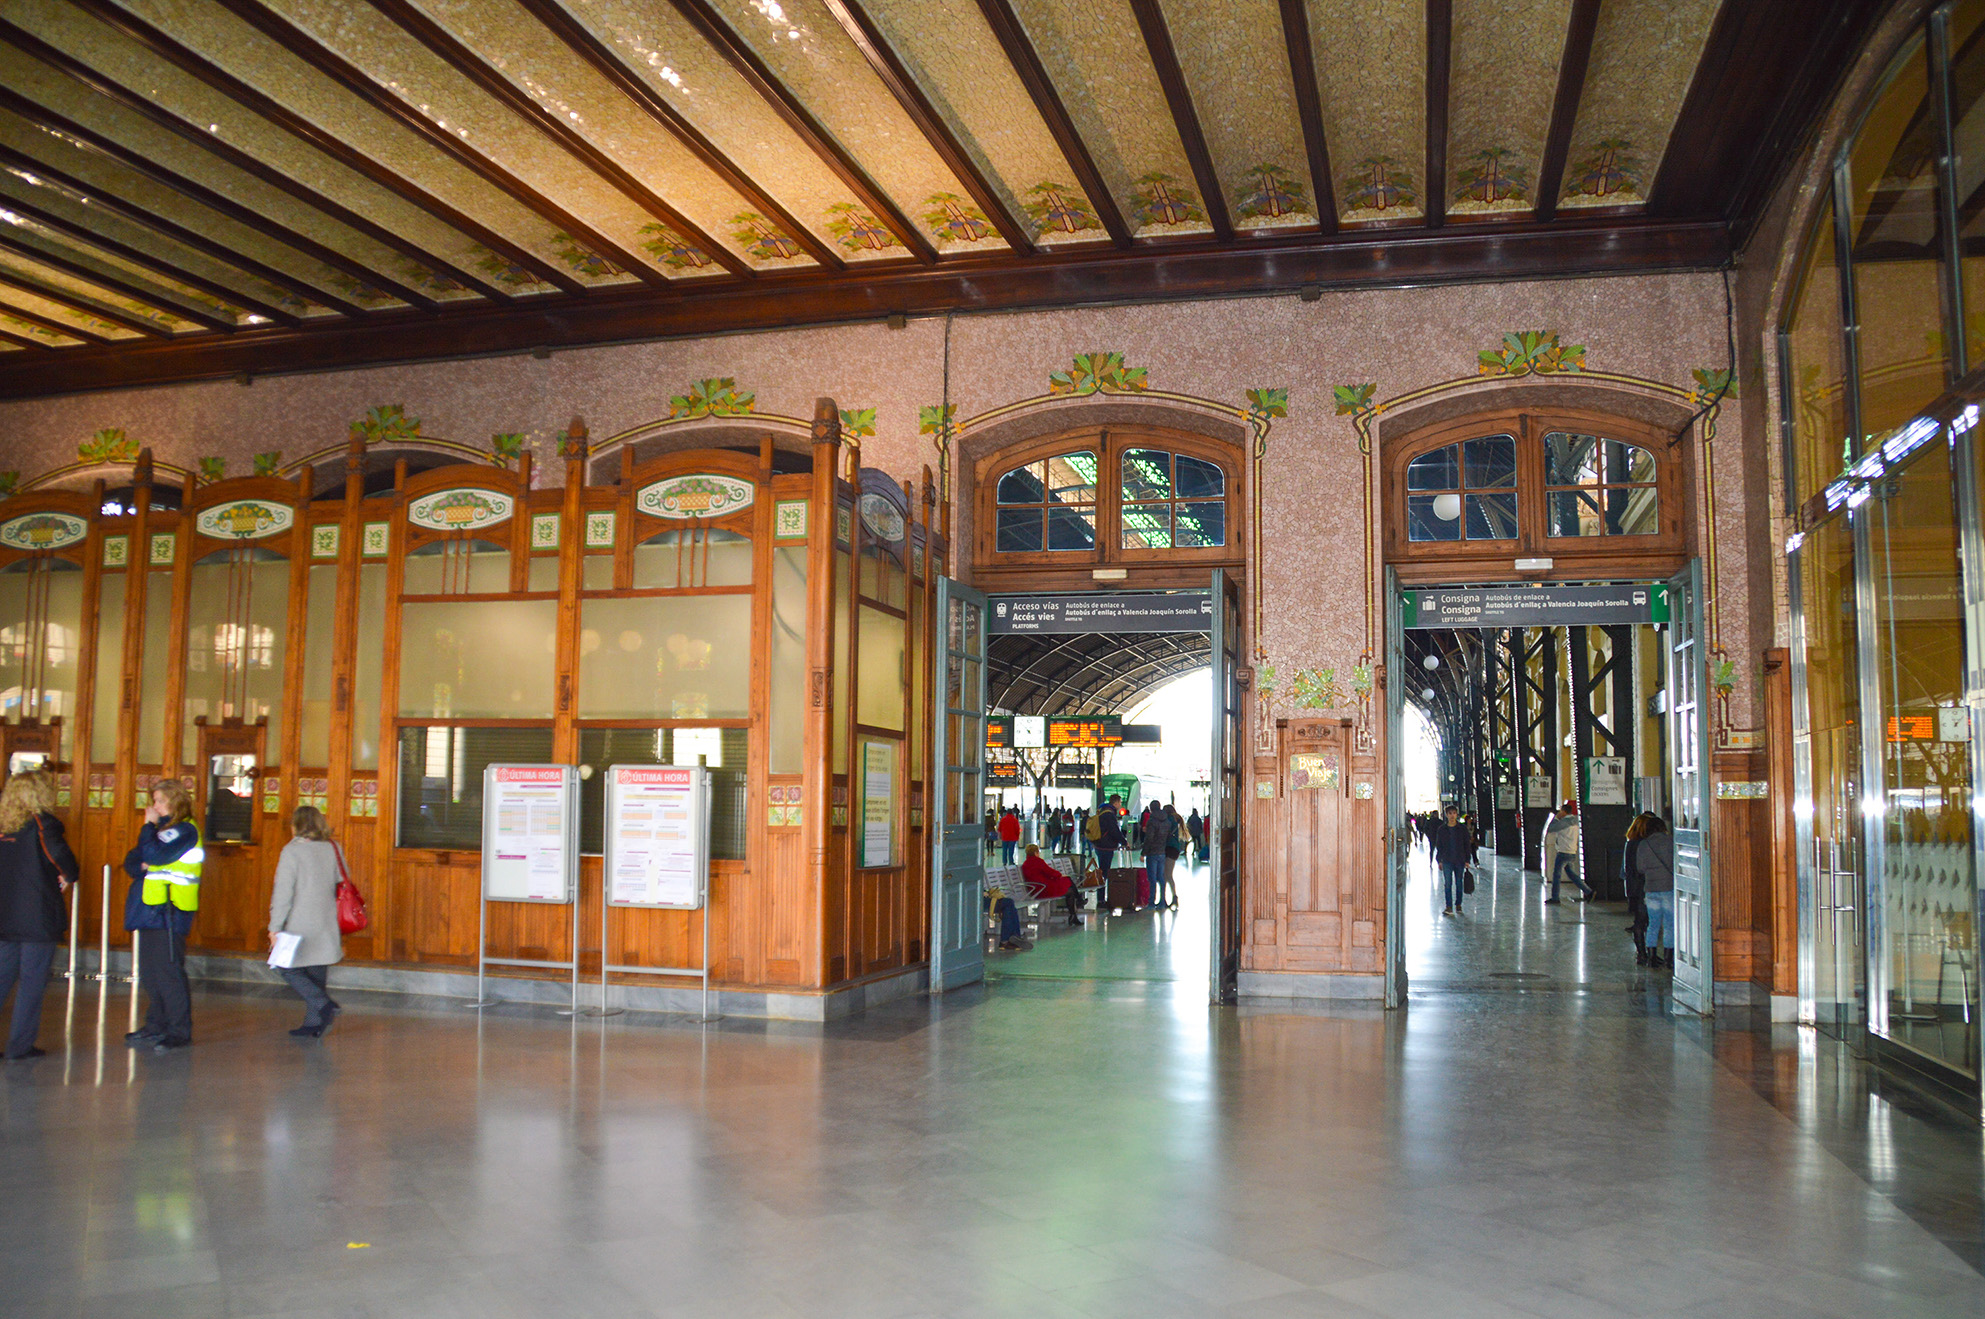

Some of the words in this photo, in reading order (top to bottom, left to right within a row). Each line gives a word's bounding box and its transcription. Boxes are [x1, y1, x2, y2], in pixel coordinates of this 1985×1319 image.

[1441, 594, 1480, 604] Consigna
[1042, 602, 1059, 610] vías
[1441, 605, 1481, 615] Consigna
[1012, 612, 1035, 621] Accés
[1149, 608, 1174, 616] Joaquín
[1299, 756, 1326, 770] Buen
[510, 769, 537, 780] ÚLTIMA
[538, 771, 560, 780] HORA
[632, 771, 662, 782] ÚLTIMA
[664, 773, 688, 782] HORA
[1306, 766, 1333, 783] Viaje
